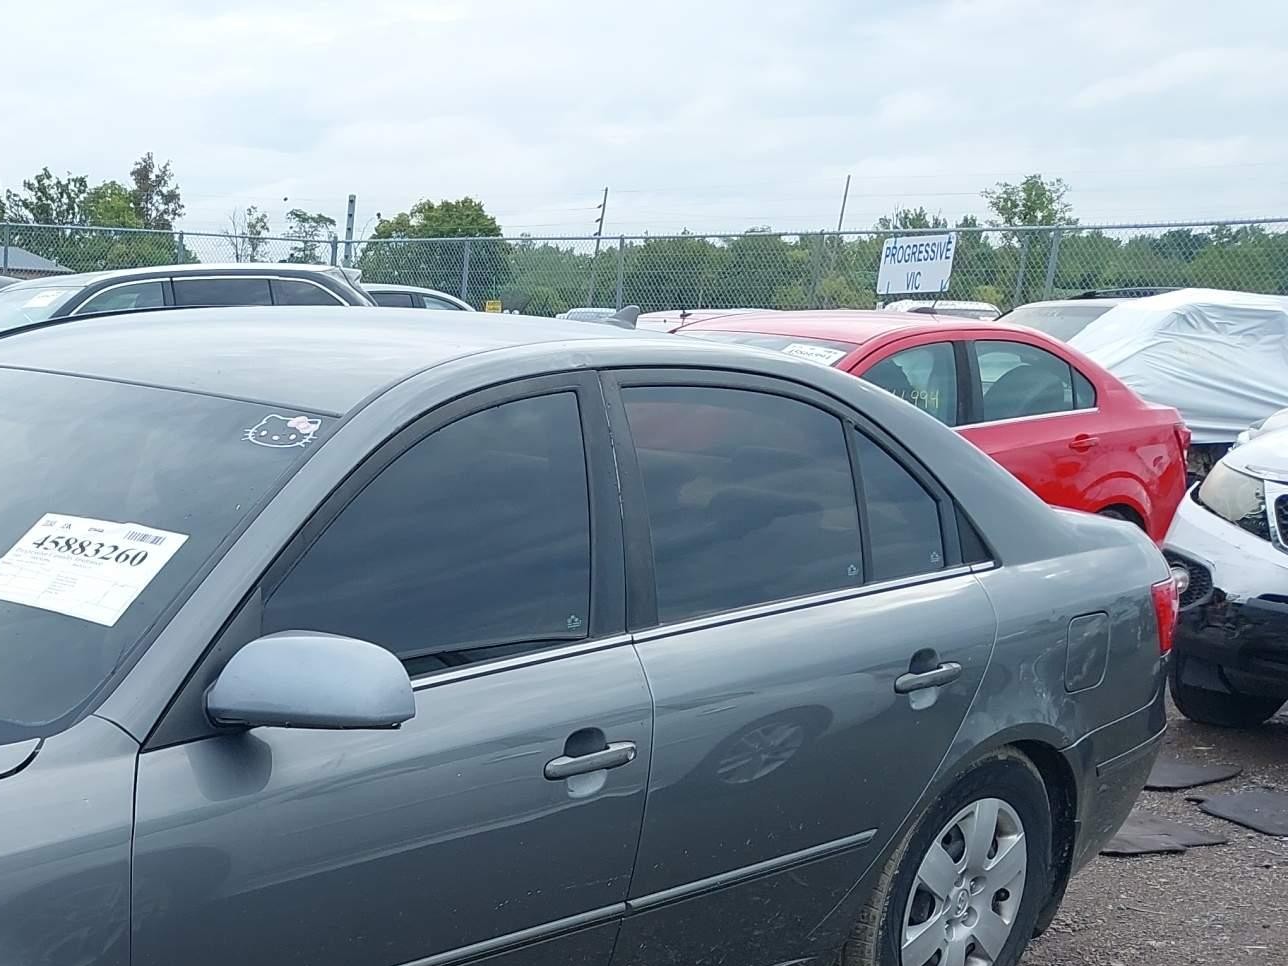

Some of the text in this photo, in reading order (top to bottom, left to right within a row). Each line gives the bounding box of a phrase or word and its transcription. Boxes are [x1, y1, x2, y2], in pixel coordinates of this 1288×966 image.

[884, 240, 953, 265] PROGRESSIVE
[906, 271, 922, 291] VIC
[32, 533, 149, 568] 45883260
